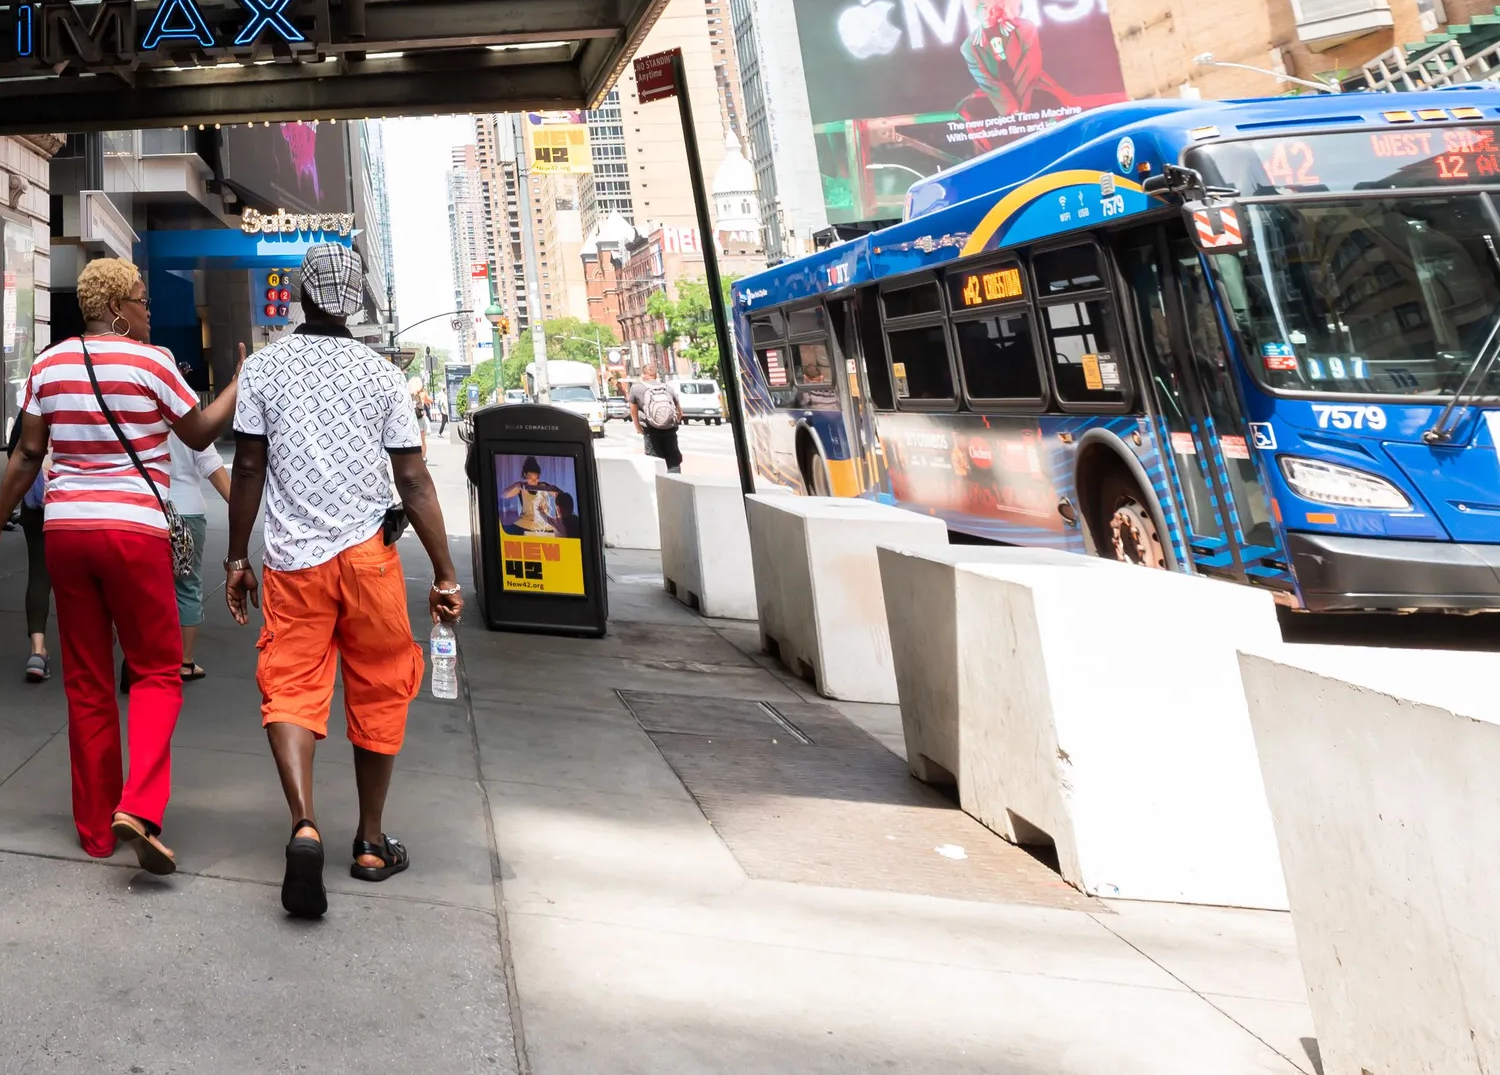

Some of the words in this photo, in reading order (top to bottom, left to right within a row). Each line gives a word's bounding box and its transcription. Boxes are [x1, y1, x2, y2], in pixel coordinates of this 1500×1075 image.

[636, 62, 645, 72] NO
[638, 70, 663, 82] Anytime
[947, 121, 965, 131] The
[965, 120, 984, 129] new
[985, 115, 1016, 127] project
[1016, 111, 1040, 122] Time
[1040, 105, 1082, 118] Machine
[533, 129, 585, 146] NEW
[946, 132, 968, 143] With
[968, 129, 1008, 140] exclusive
[1008, 124, 1026, 135] film
[1370, 131, 1433, 157] WEST
[535, 147, 569, 163] 42
[1434, 155, 1469, 178] 12
[1099, 194, 1125, 217] 7579
[241, 206, 355, 236] Subway
[1311, 404, 1388, 431] 7579
[503, 540, 561, 562] NEW
[505, 560, 544, 580] 42
[506, 580, 545, 590] New42.org
